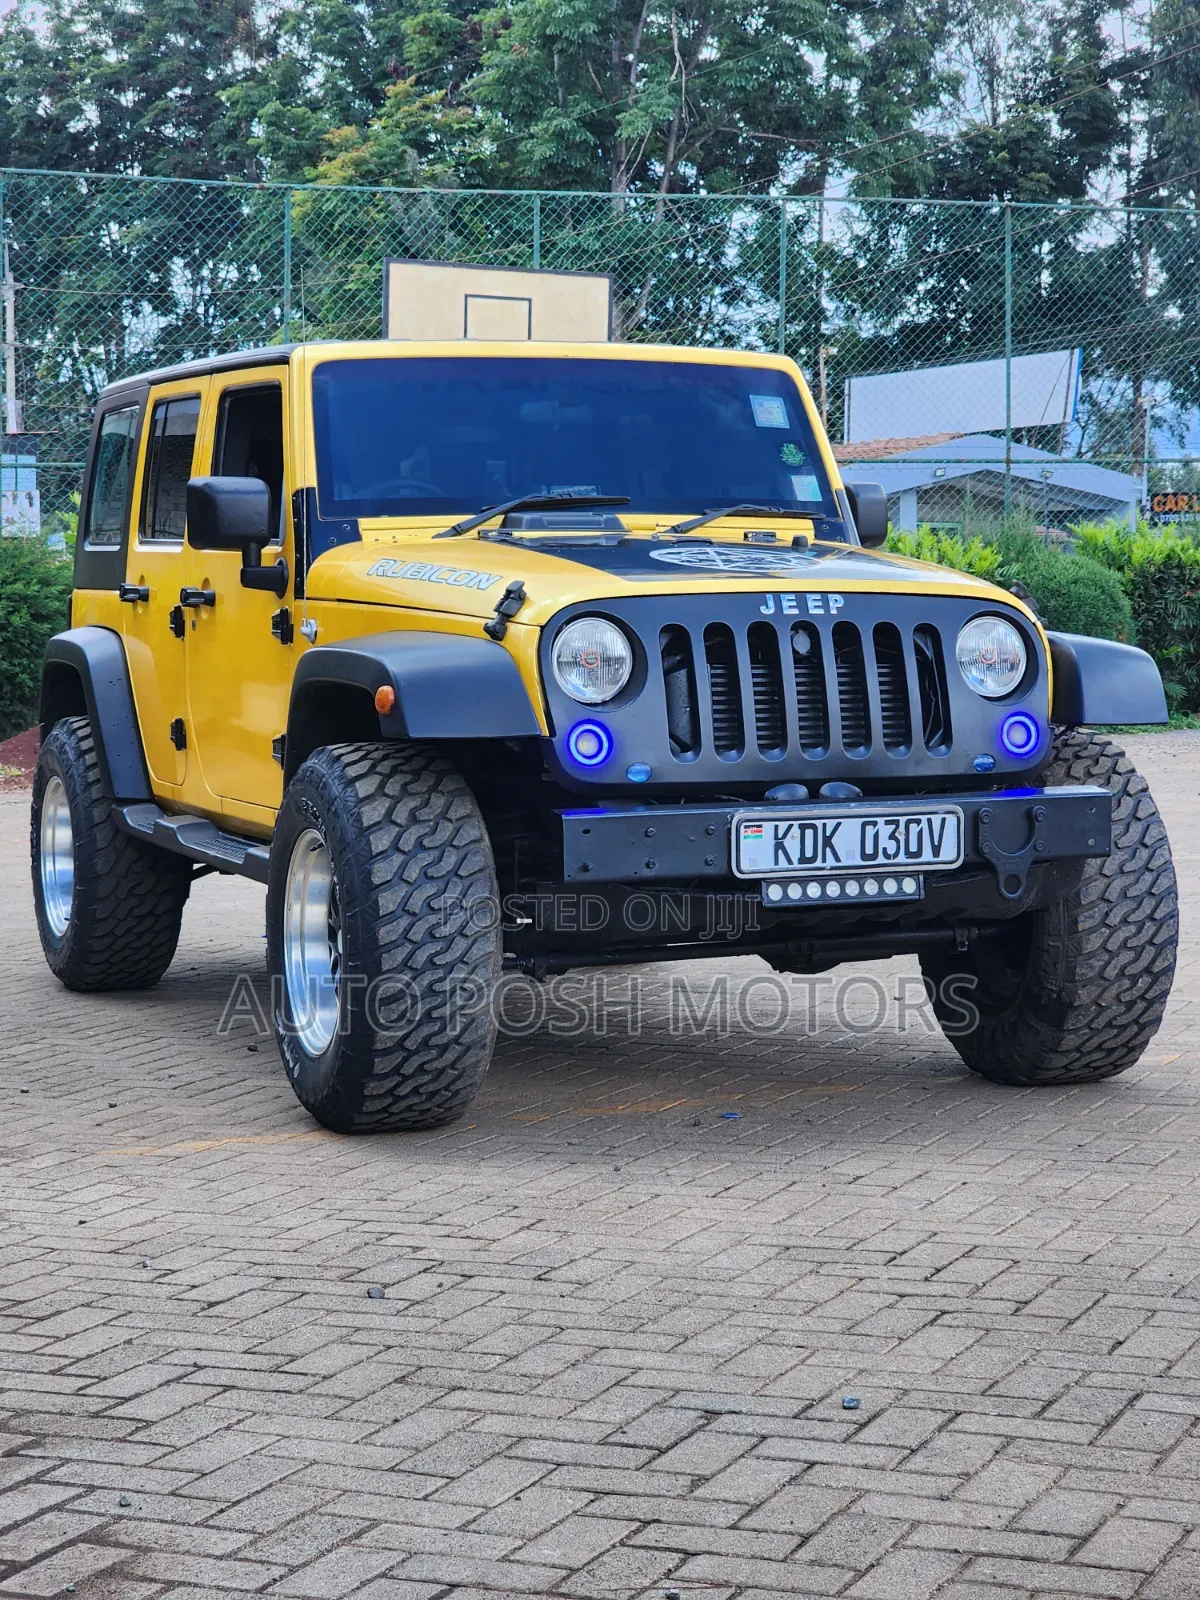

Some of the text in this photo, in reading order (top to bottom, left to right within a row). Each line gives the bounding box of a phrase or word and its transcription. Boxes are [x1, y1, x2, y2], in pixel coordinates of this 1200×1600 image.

[1152, 495, 1189, 512] CAR
[366, 558, 504, 591] RUBICON
[759, 593, 845, 615] JEEP
[773, 821, 843, 866] KDK
[860, 816, 947, 862] 030V
